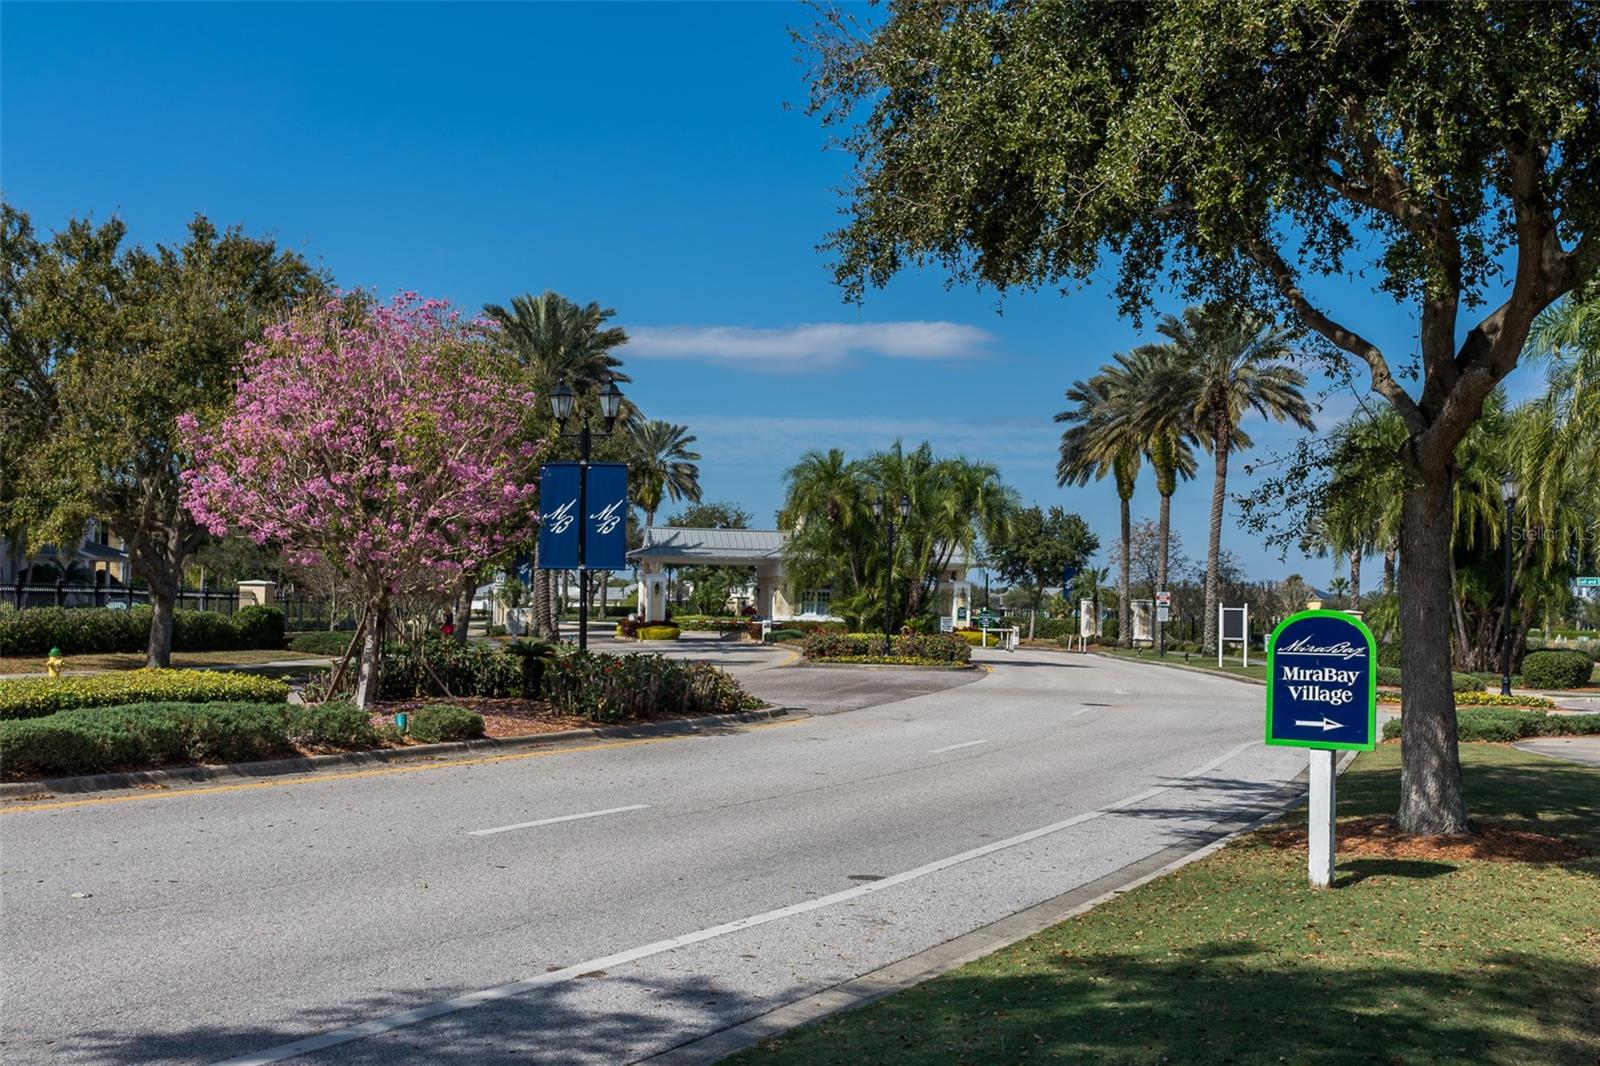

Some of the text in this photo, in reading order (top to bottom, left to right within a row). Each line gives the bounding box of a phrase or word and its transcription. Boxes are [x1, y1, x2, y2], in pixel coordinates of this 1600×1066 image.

[1278, 634, 1366, 660] MiraBay
[1282, 666, 1360, 687] MiraBay
[1289, 686, 1353, 706] Village
